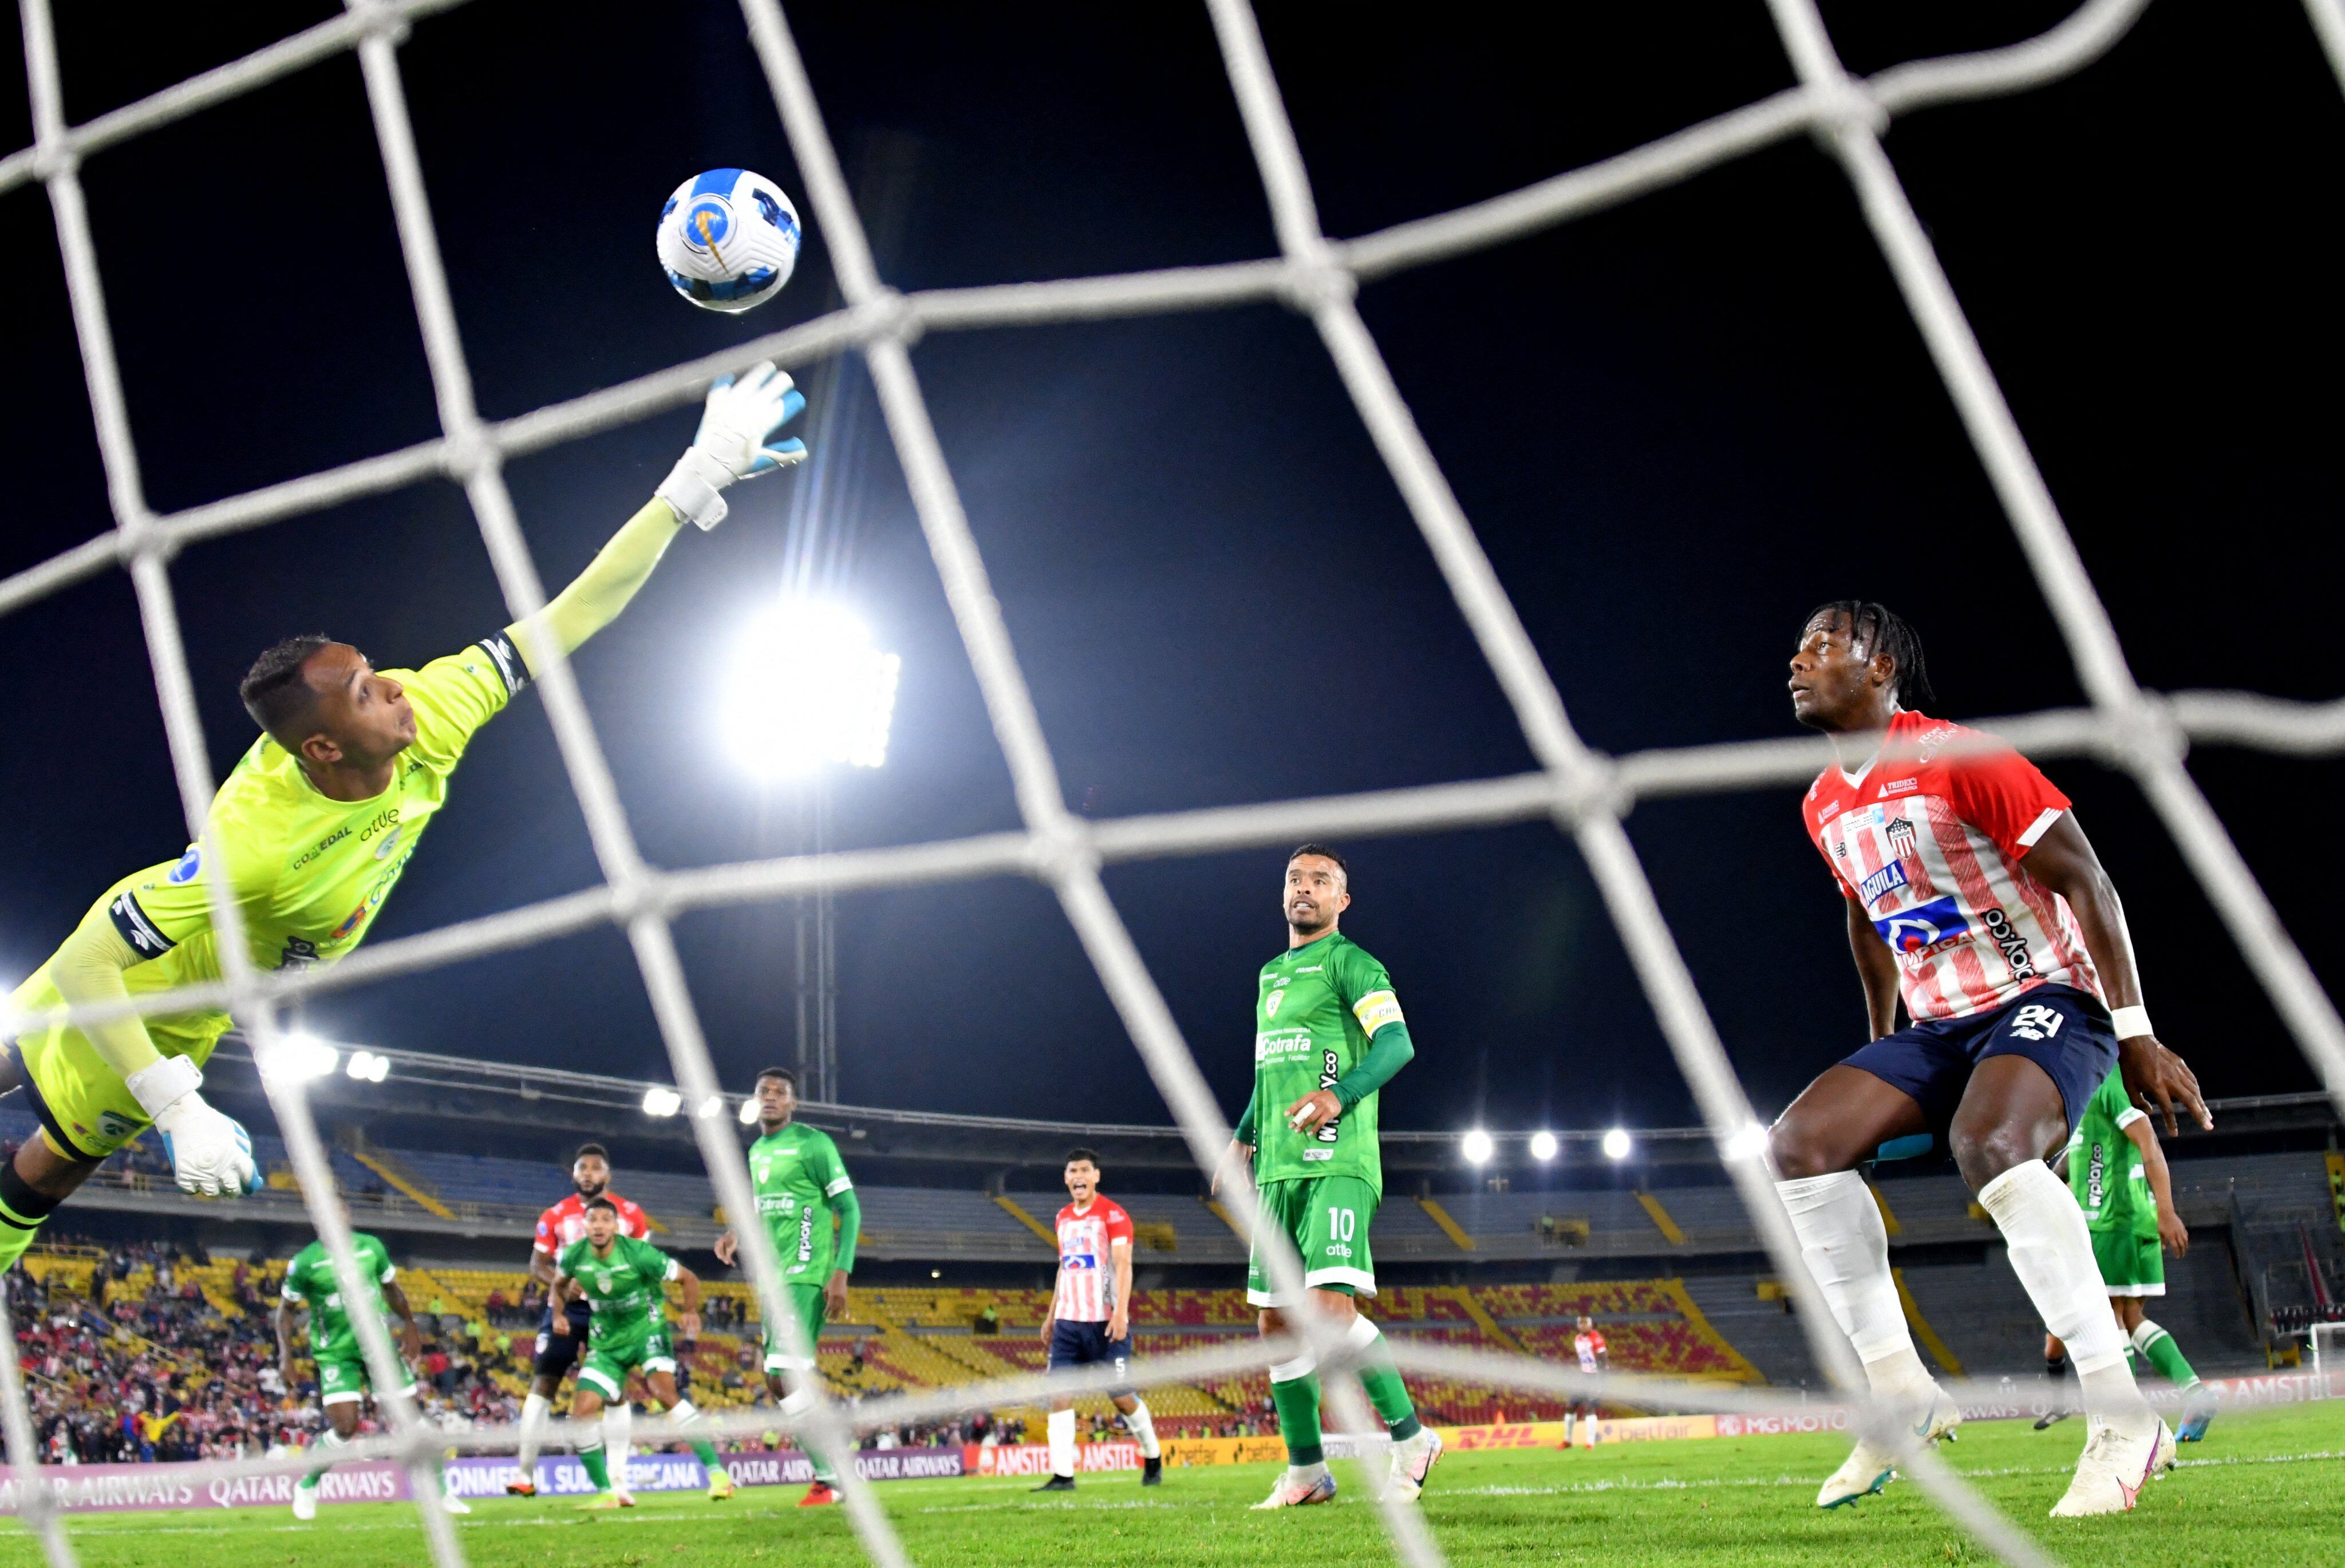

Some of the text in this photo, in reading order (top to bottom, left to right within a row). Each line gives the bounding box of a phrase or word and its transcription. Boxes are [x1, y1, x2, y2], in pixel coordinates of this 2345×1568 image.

[1892, 830, 1911, 840] JUNIOR
[2012, 1004, 2064, 1038] 24
[2087, 1144, 2104, 1207] wplay.co
[1328, 1207, 1355, 1242] 10
[1115, 1358, 1126, 1373] 5
[1458, 1427, 1539, 1449] DHL
[855, 1454, 960, 1482] QATAR AIRWAYS
[996, 1447, 1052, 1476] AMSTE
[1082, 1443, 1139, 1472] AMSTEL
[728, 1460, 779, 1488] QATAR
[78, 1475, 194, 1506] AIRWAYS
[208, 1474, 293, 1510] QATAR
